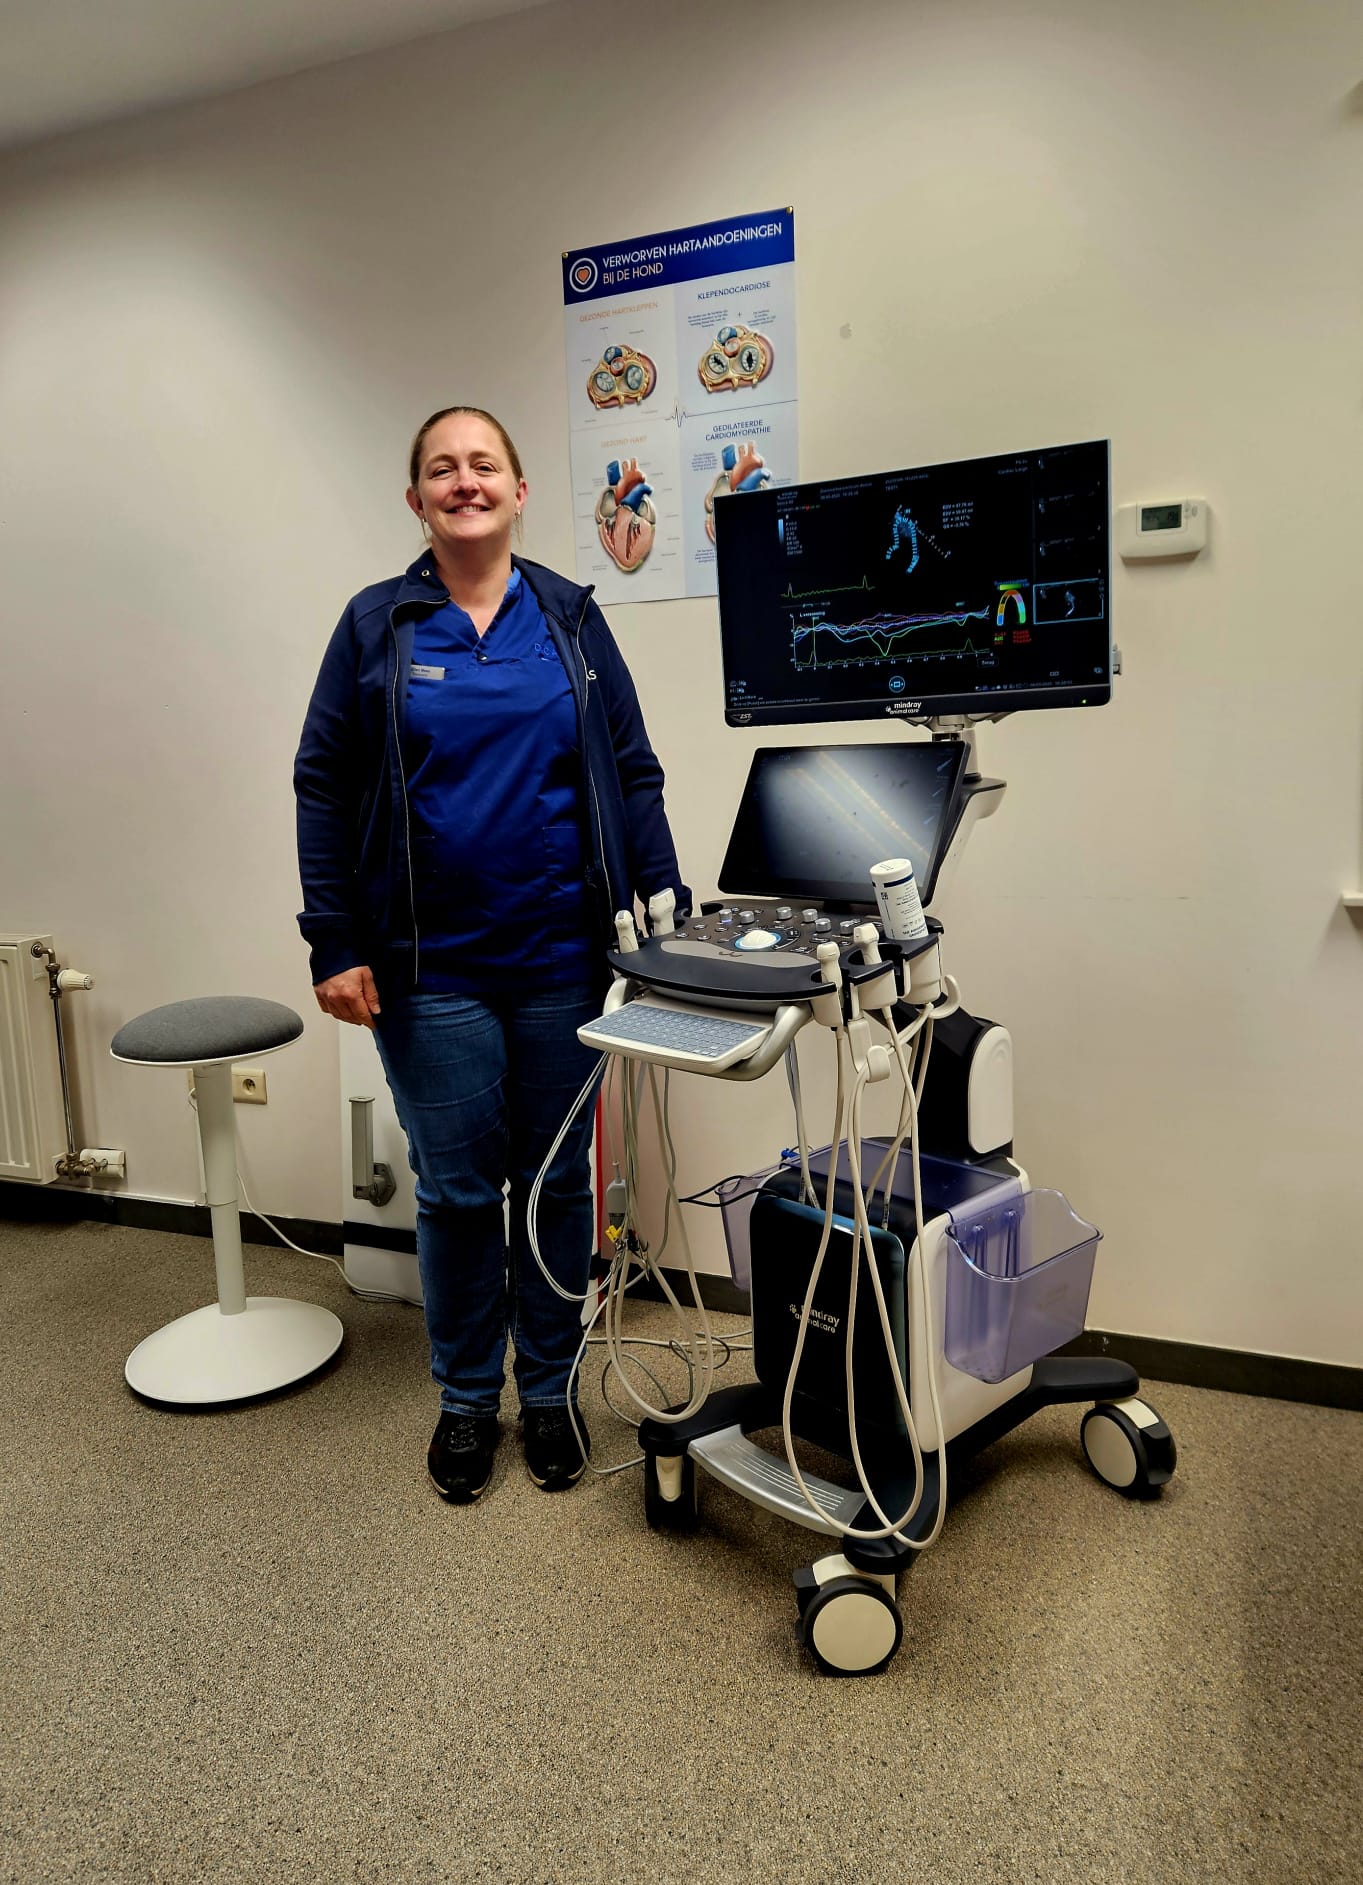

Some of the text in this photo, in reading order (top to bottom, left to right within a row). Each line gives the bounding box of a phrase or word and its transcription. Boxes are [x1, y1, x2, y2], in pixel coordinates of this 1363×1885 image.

[603, 222, 782, 268] VERWORVEN HARTAANDOENINGEN
[603, 262, 664, 284] BIJ DE HOND
[697, 280, 771, 300] KLEPENDOCARDIOSE
[705, 426, 772, 441] CARDIOMYOPATHIE
[713, 419, 763, 432] GEDILATEERDE
[894, 701, 922, 709] mindray
